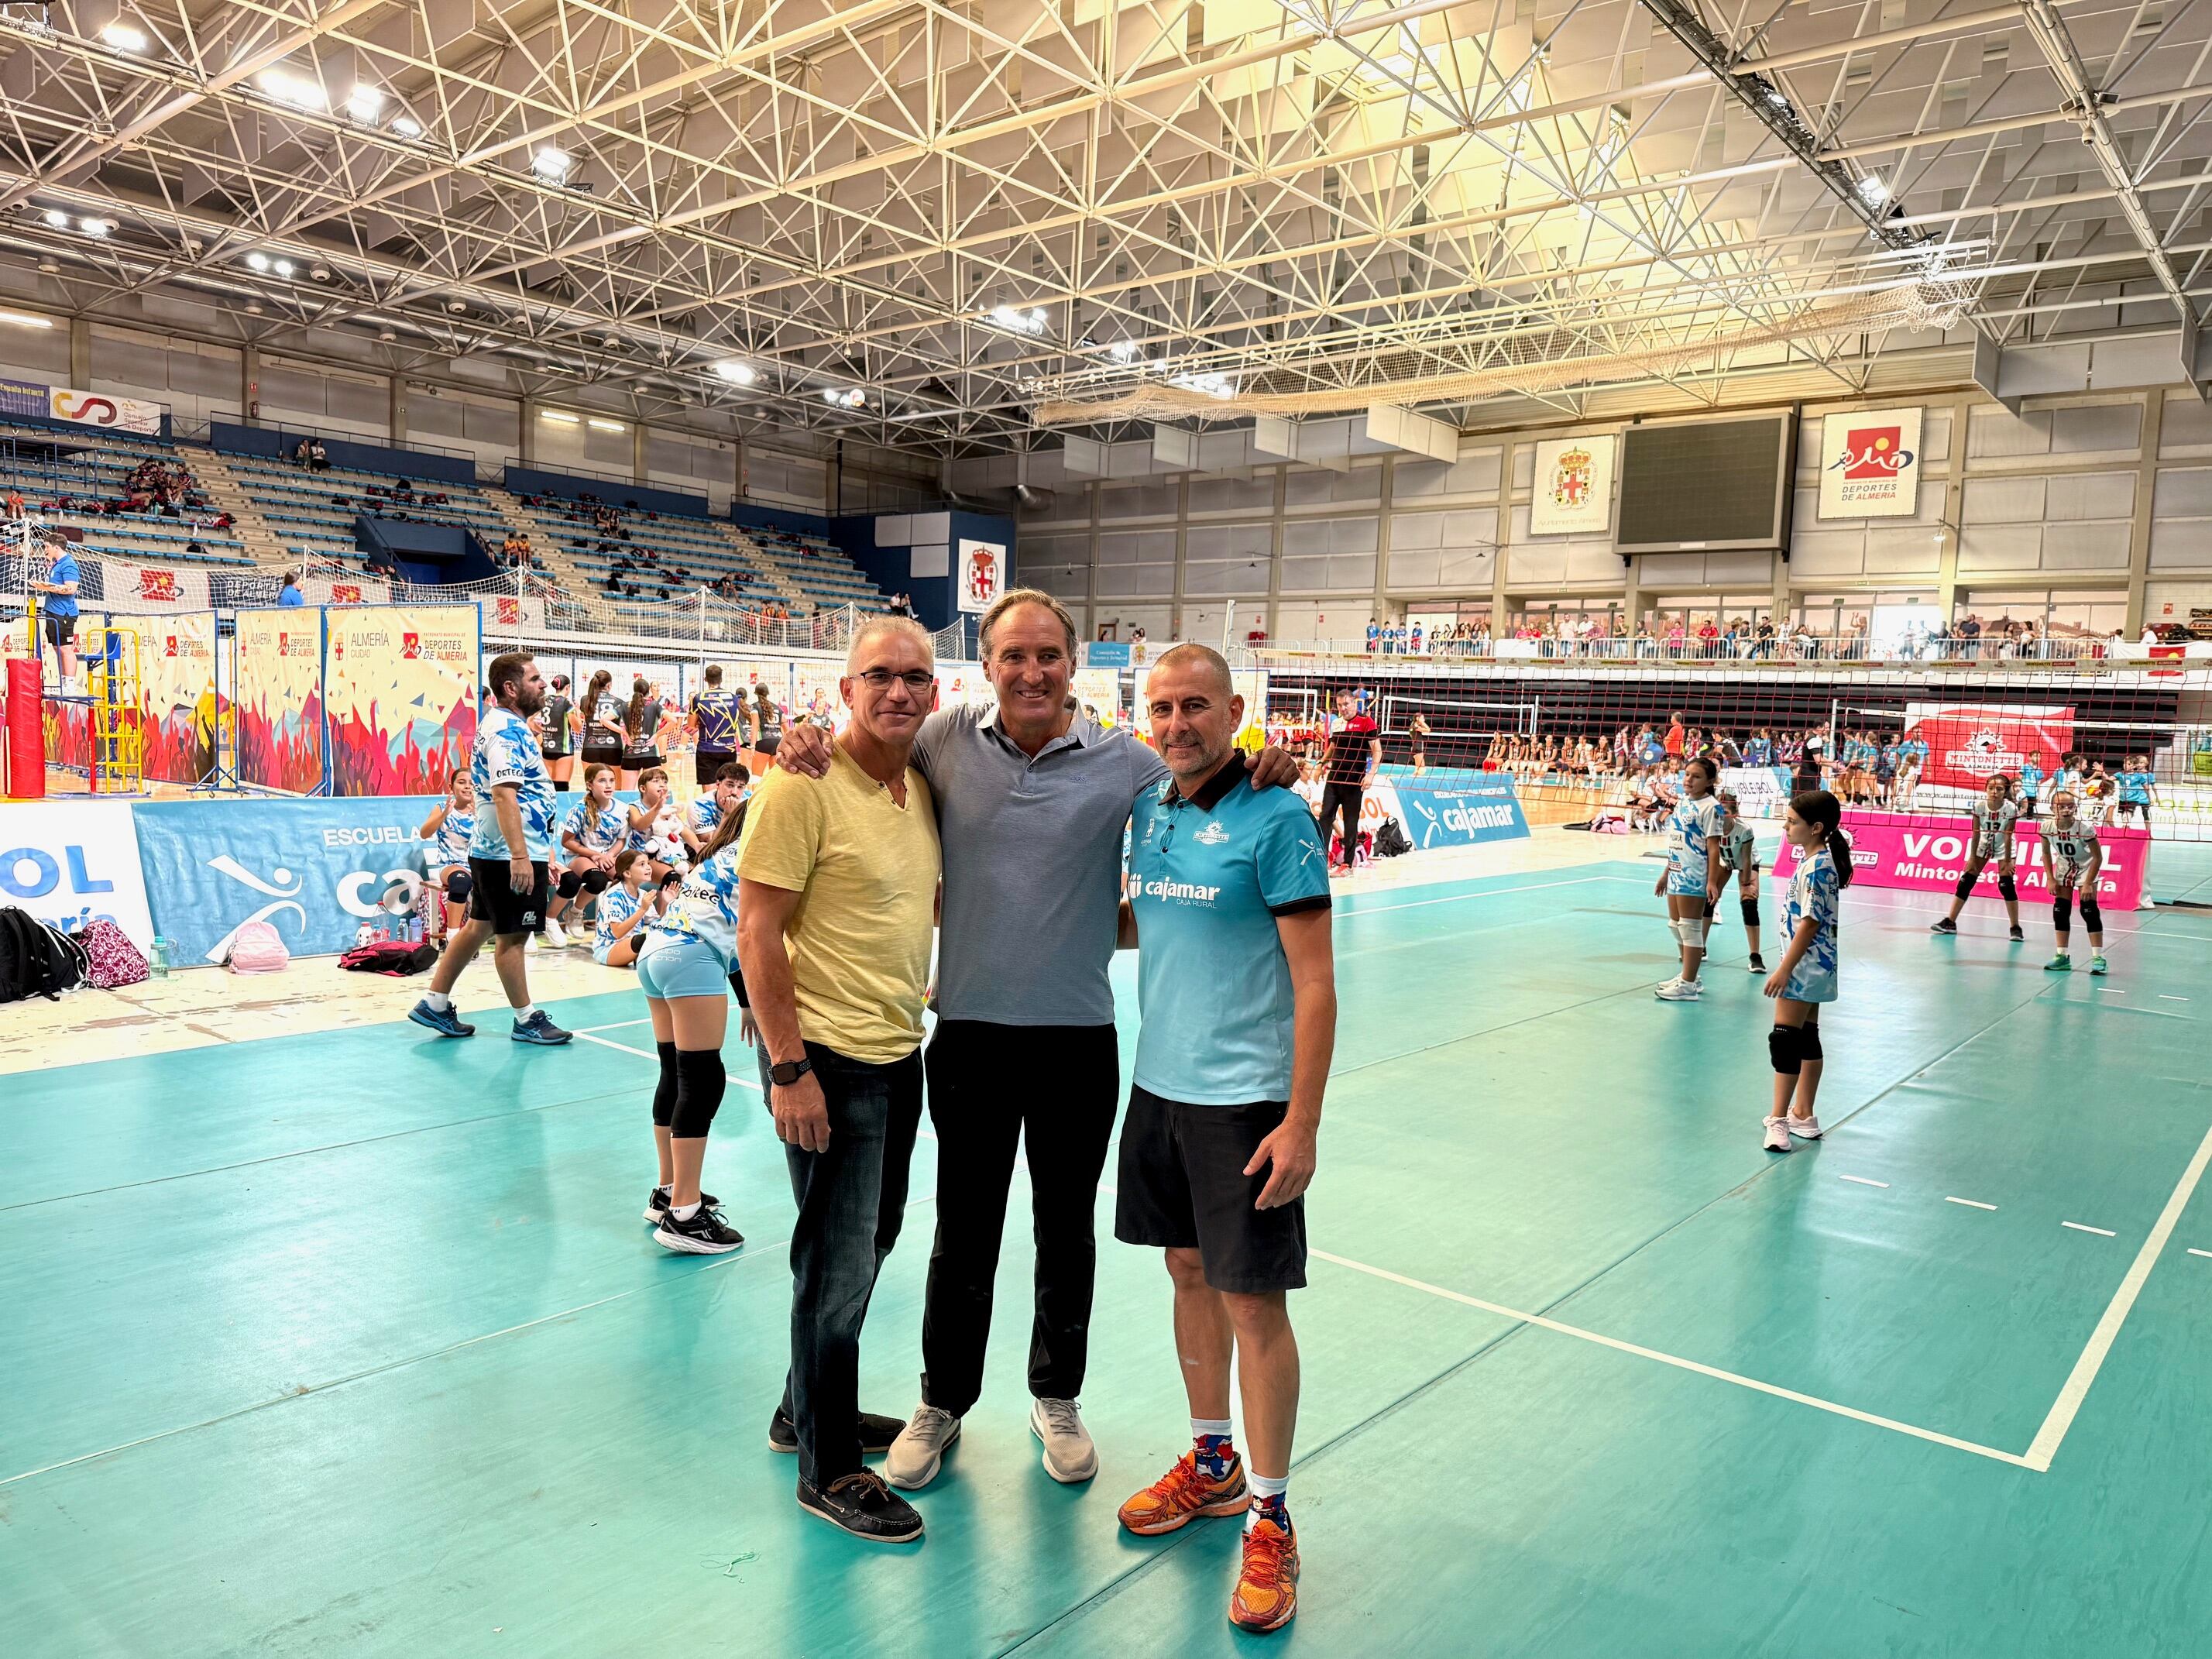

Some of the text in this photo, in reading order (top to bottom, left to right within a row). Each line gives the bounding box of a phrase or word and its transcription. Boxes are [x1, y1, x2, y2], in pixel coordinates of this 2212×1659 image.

[1843, 483, 1897, 493] DEPORTES
[1856, 491, 1896, 501] ALMERIA
[227, 589, 241, 597] DE
[290, 639, 313, 647] DEPORTES
[351, 629, 390, 647] ALMERÍA
[424, 640, 462, 650] DEPORTES
[290, 648, 297, 657] DE
[350, 648, 371, 658] CIUDAD
[423, 651, 468, 661] DE ALMERIA
[1949, 754, 2020, 764] MINTONETTE
[1733, 781, 1774, 795] VOLEIBOL
[1442, 799, 1515, 840] cajamar
[2056, 842, 2076, 856] 10
[1145, 876, 1221, 902] cajamar
[1192, 900, 1218, 909] RURAL
